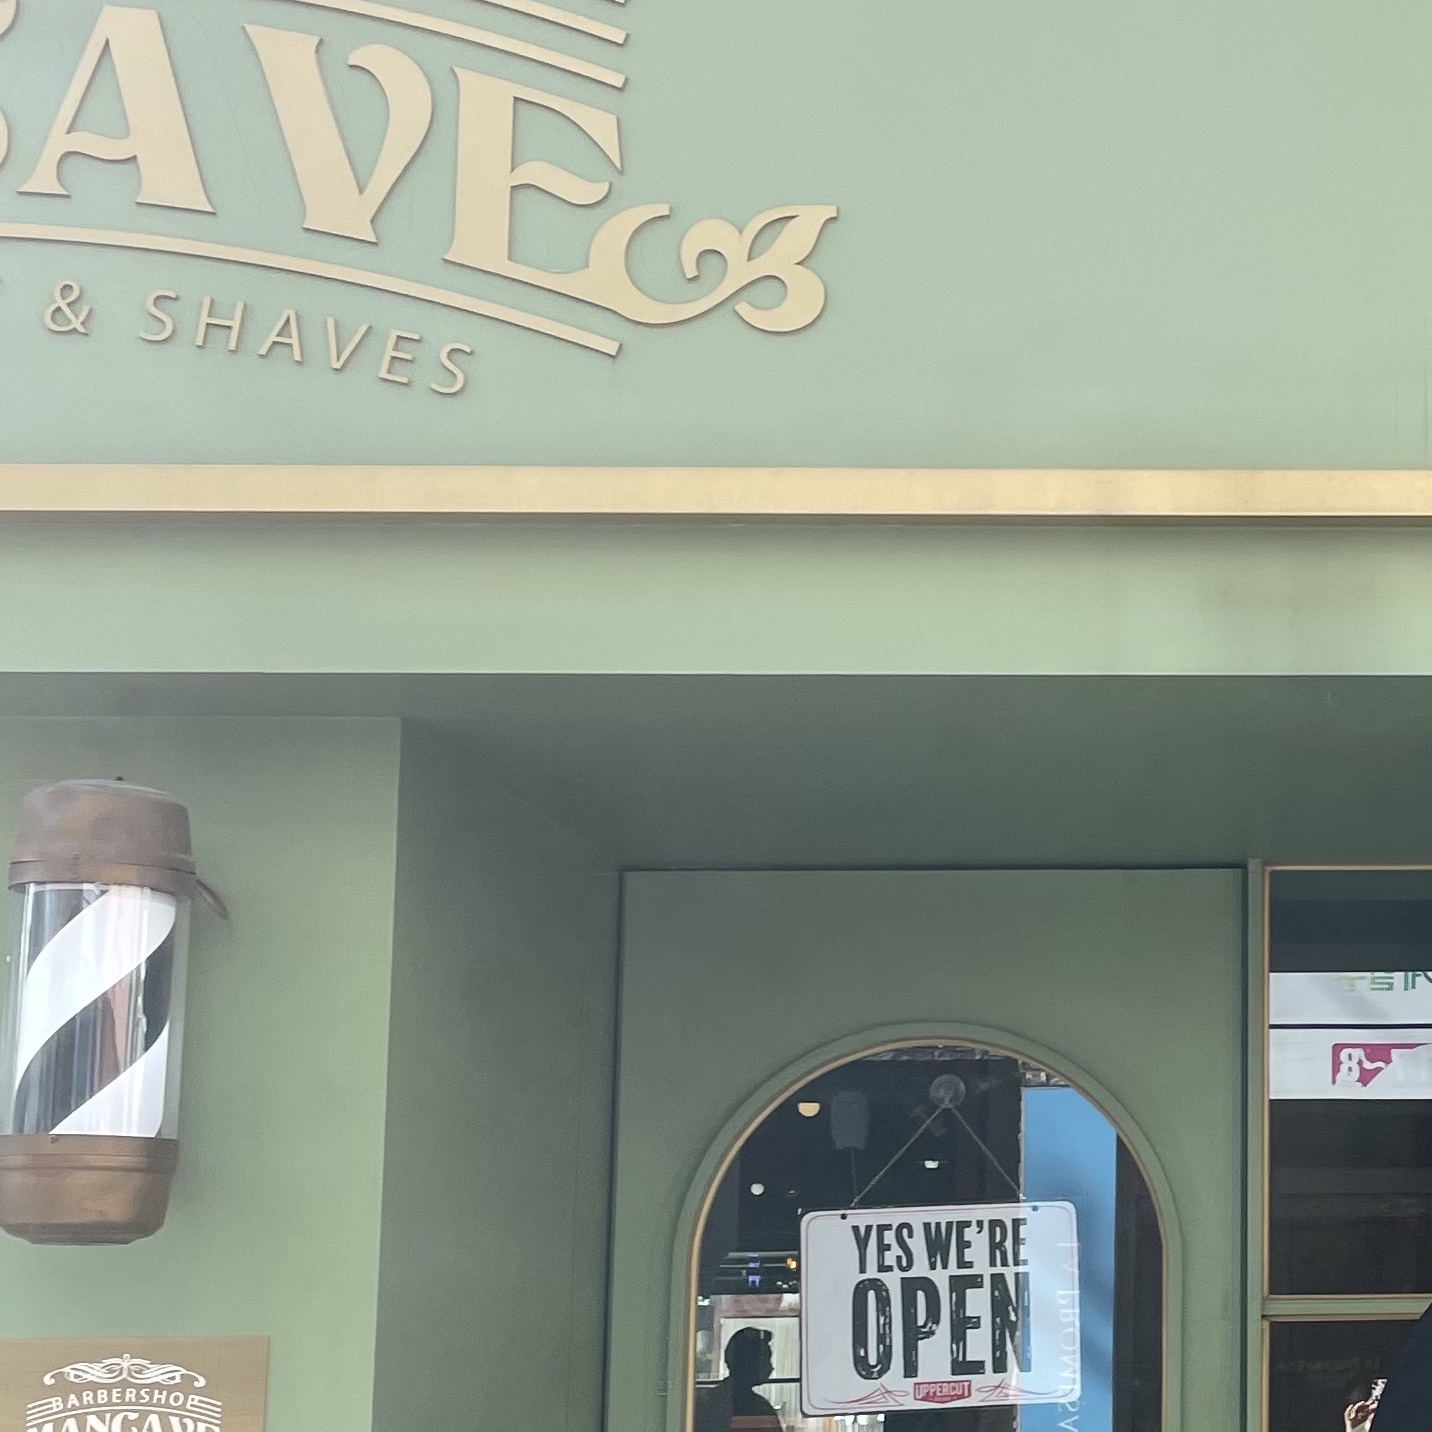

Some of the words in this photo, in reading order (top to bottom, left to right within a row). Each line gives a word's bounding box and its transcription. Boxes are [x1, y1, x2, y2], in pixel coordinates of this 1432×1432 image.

[0, 0, 632, 290] AVE
[43, 281, 92, 335] &
[139, 289, 475, 395] SHAVES
[851, 1221, 914, 1274] YES
[922, 1218, 1028, 1271] WE'RE
[852, 1272, 1032, 1380] OPEN
[51, 1388, 201, 1412] BARBERSHOP
[915, 1382, 970, 1399] UPPERCUT
